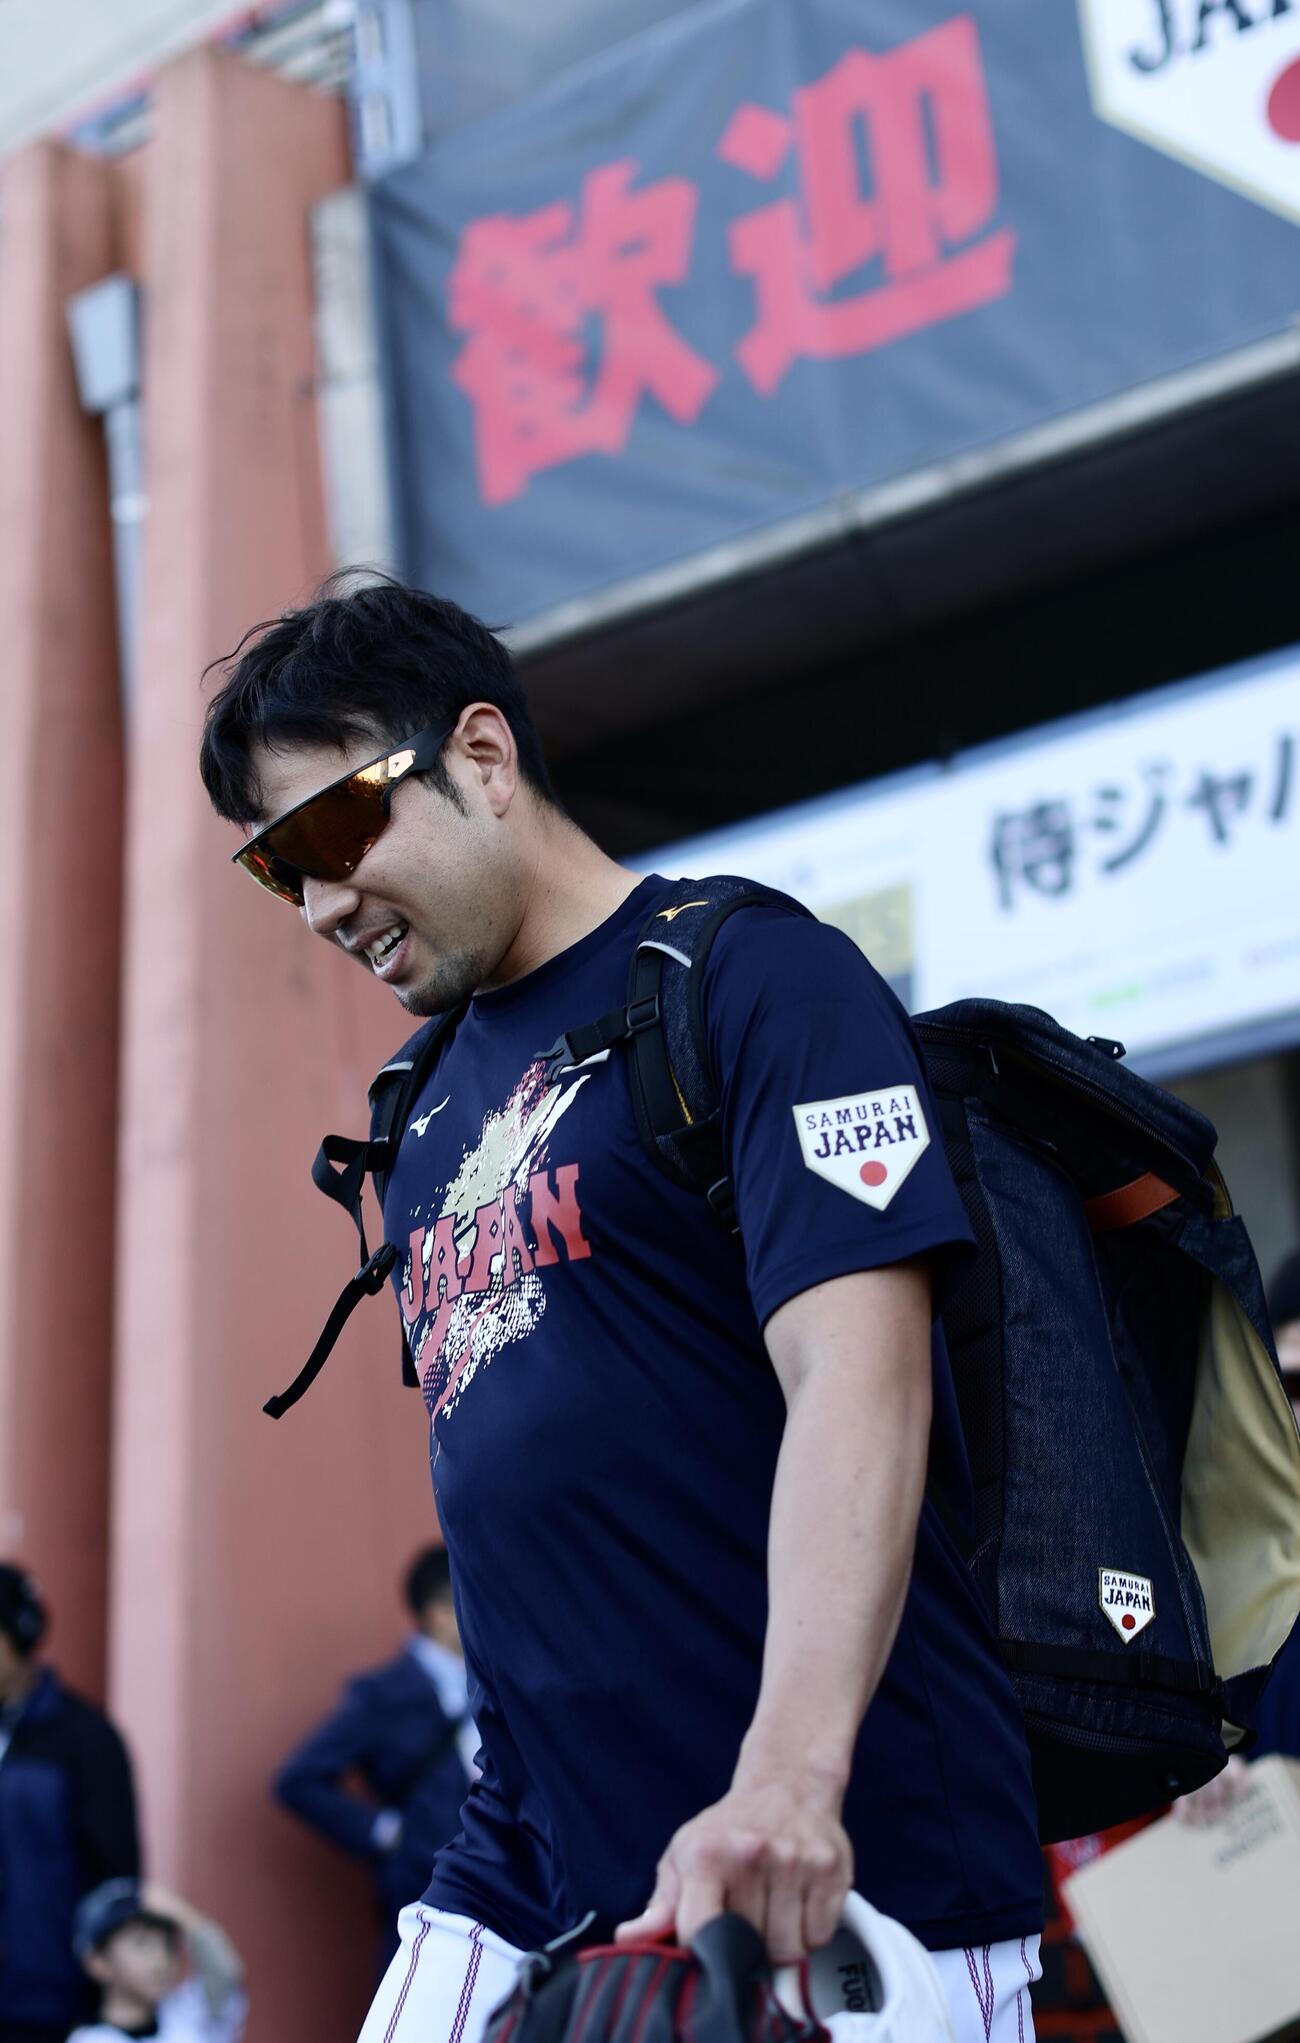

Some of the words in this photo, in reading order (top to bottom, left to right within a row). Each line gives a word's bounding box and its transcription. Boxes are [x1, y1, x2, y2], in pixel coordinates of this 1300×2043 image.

[451, 16, 1014, 504] 歓迎
[805, 1096, 912, 1131] SAMURAI
[814, 1115, 918, 1158] JAPAN
[400, 1163, 592, 1324] JAPAN
[1104, 1575, 1149, 1593] SAMURAI
[1104, 1588, 1151, 1612] JAPAN
